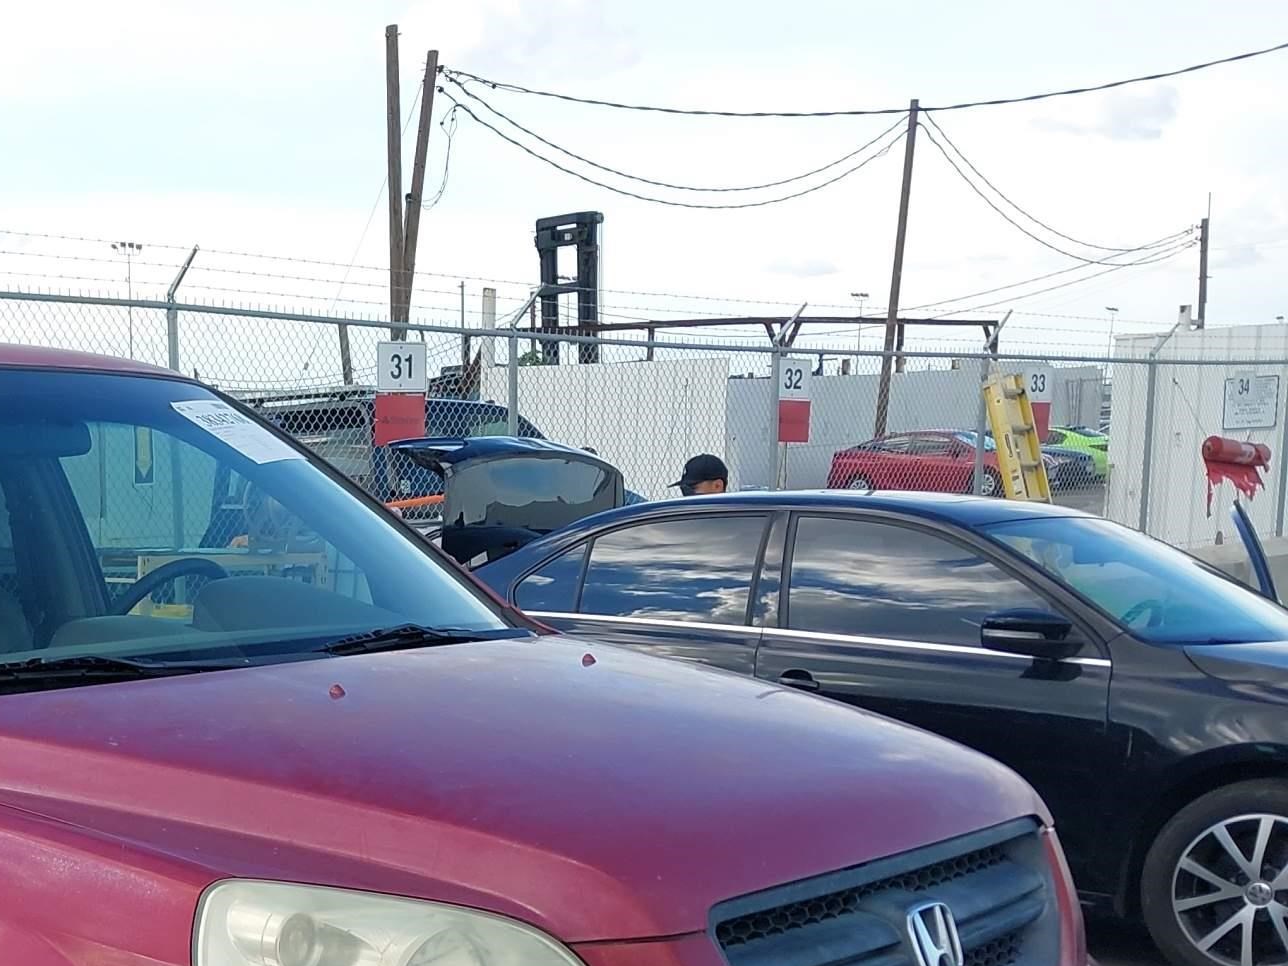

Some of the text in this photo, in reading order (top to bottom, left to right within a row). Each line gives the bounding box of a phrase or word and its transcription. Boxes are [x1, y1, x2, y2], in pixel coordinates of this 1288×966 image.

[390, 354, 413, 379] 31
[783, 367, 803, 390] 32
[1030, 374, 1046, 393] 33
[1238, 378, 1250, 395] 34
